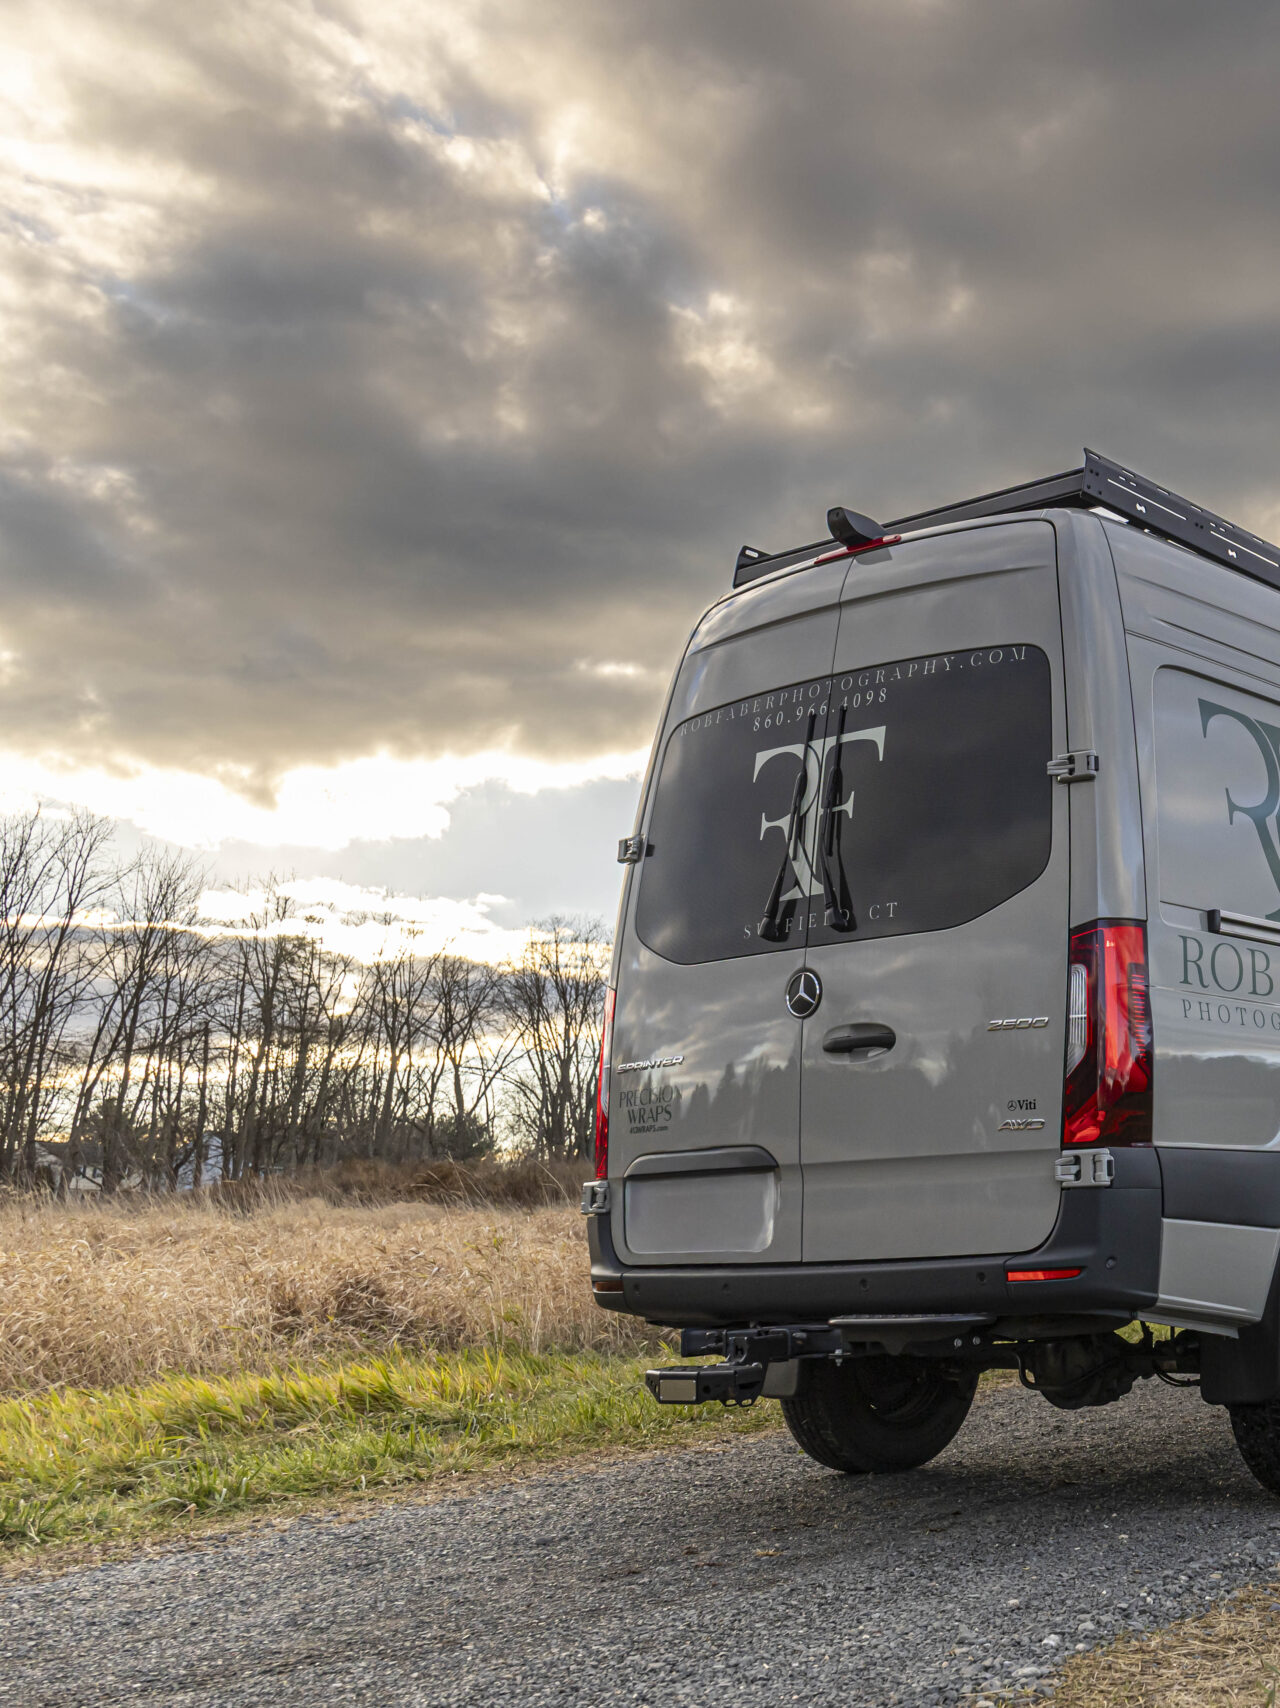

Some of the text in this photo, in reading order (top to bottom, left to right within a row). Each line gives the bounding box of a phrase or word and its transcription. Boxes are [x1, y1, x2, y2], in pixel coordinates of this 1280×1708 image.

[681, 646, 1026, 736] ROBFABERPHOTOGRAPHY.COM
[752, 688, 887, 732] 860.966.4098
[744, 902, 898, 939] SFIELD CT
[1178, 935, 1274, 996] ROB
[987, 1017, 1048, 1031] 2500
[617, 1056, 684, 1074] SPRINTER
[619, 1085, 682, 1109] PRECISION
[1017, 1099, 1037, 1110] Viti
[627, 1104, 672, 1124] WRAPS
[997, 1118, 1046, 1131] AWD
